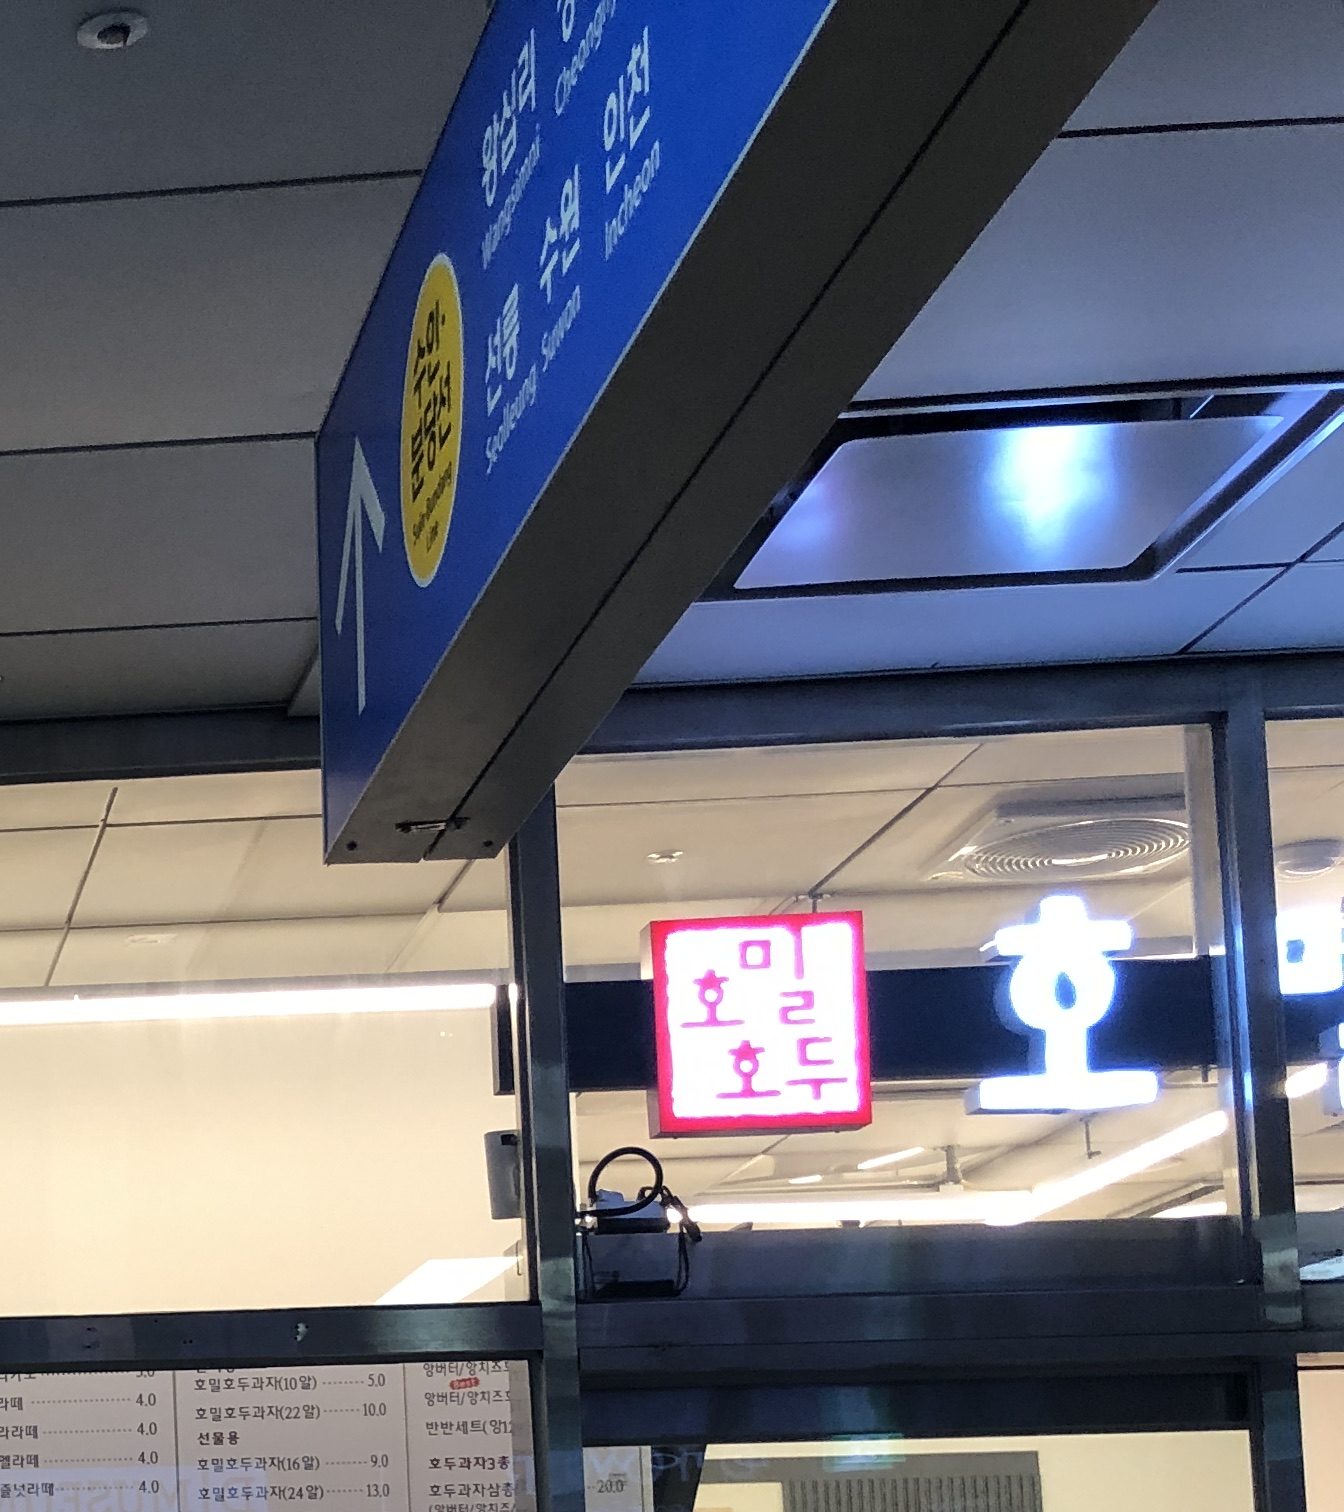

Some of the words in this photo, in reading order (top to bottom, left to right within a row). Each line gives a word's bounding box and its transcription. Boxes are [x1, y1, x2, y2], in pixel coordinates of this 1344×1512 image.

[482, 27, 535, 207] 왕십리
[605, 140, 660, 261] Incheon
[486, 284, 519, 416] 선릉
[539, 164, 580, 303] 수원
[604, 26, 650, 195] 인천
[412, 361, 451, 502] 분당선
[717, 1035, 847, 1100] 호두
[136, 1394, 156, 1406] 4.0
[368, 1374, 385, 1387] 5.0
[197, 1431, 239, 1445] 선물용
[370, 1455, 388, 1468] 9.0
[139, 1481, 159, 1493] 4.0
